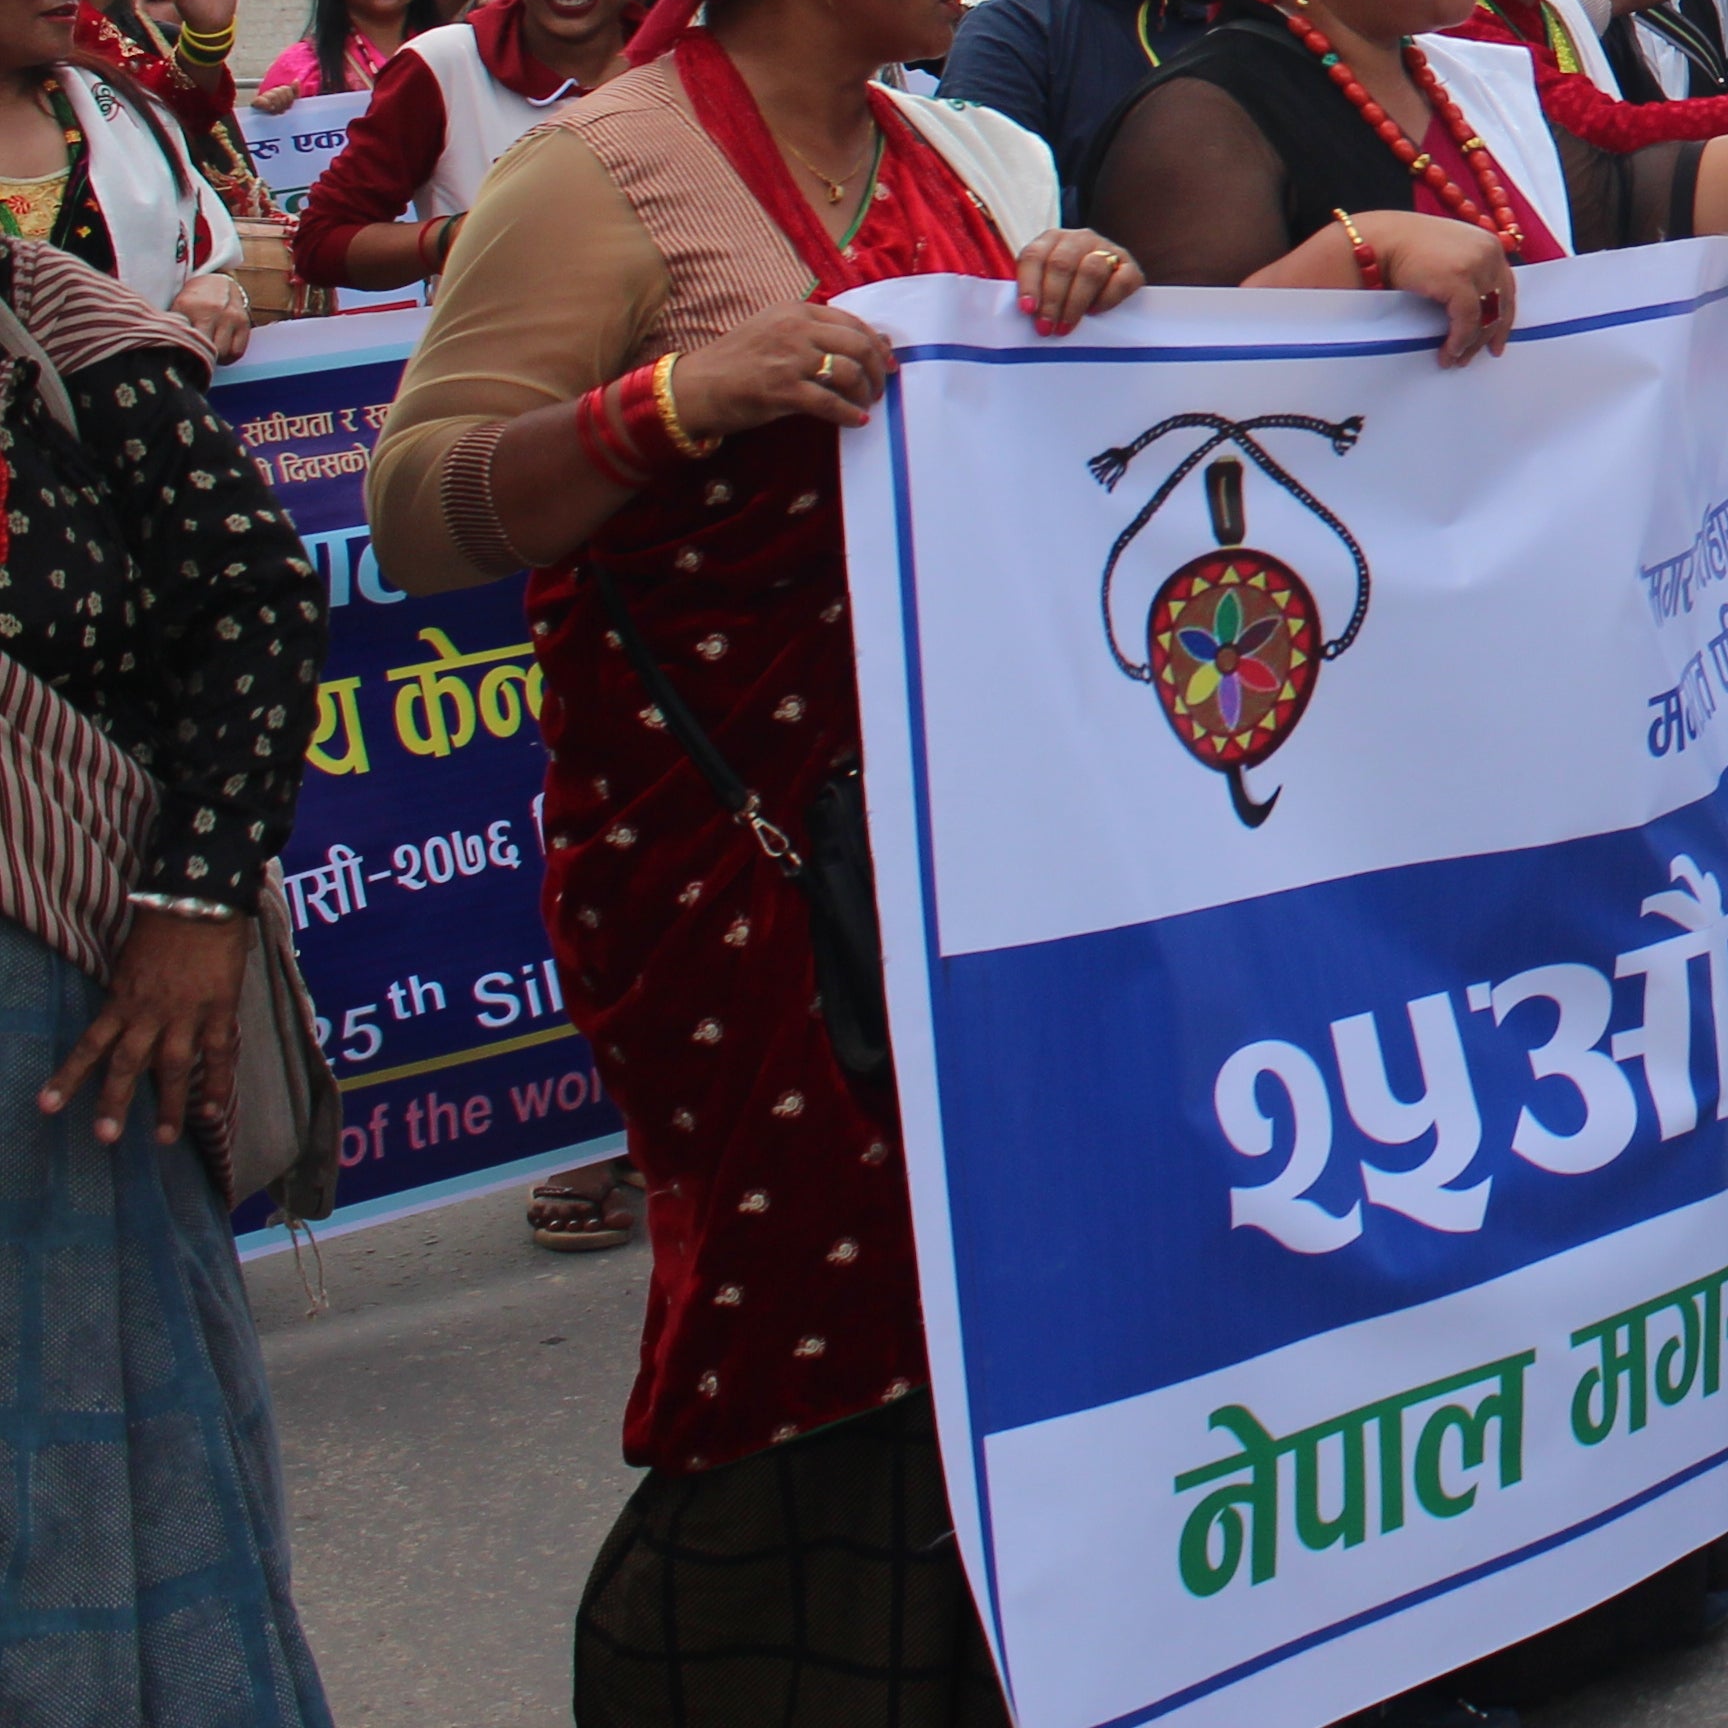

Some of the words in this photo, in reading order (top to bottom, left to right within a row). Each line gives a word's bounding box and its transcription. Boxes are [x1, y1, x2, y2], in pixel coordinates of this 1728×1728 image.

[340, 408, 360, 433] र
[404, 1087, 495, 1152] the
[1173, 1349, 1538, 1600] नेपाल
